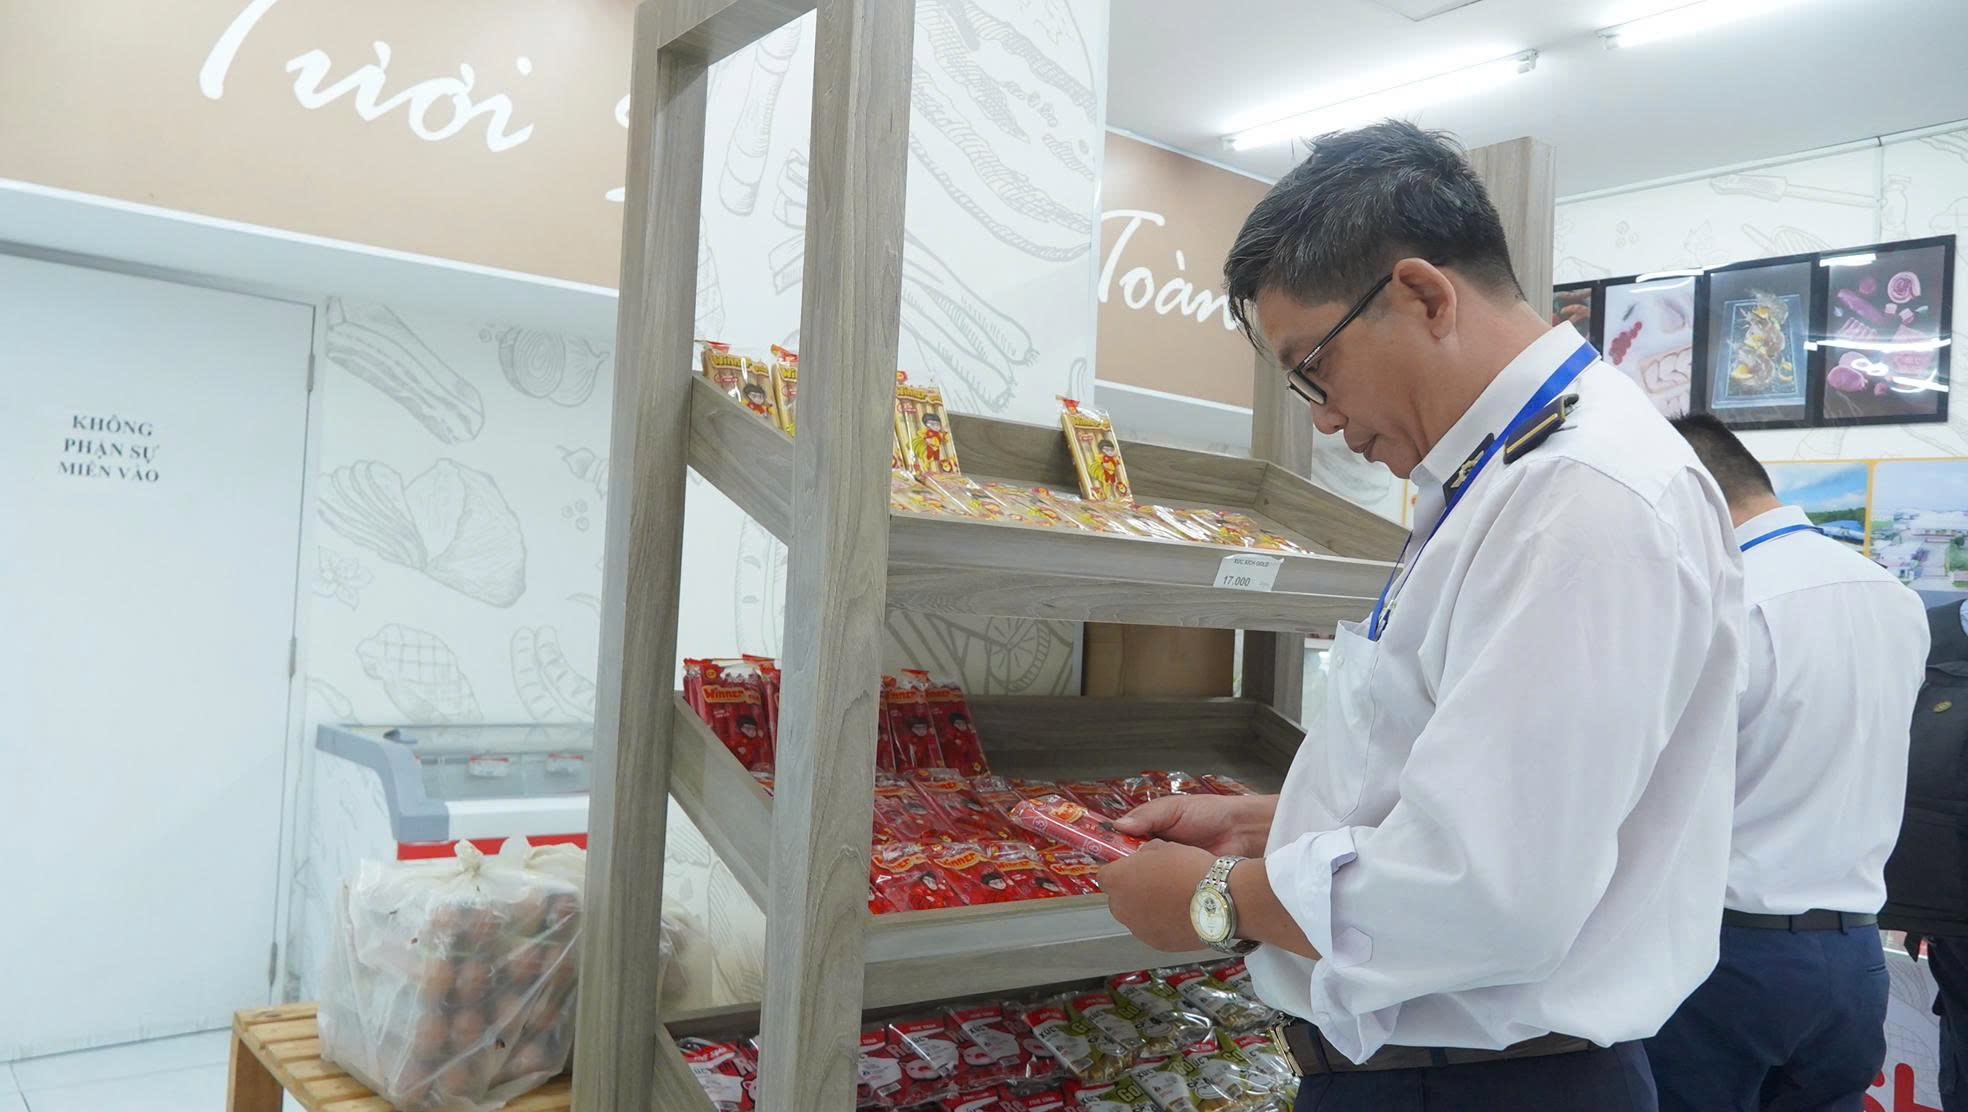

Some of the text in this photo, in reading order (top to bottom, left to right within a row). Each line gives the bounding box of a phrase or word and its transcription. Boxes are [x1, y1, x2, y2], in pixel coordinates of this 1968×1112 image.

[1098, 209, 1238, 331] Toàn
[72, 414, 153, 437] KHÔNG
[129, 443, 160, 464] SỰ
[118, 464, 159, 482] VÀO
[1223, 575, 1251, 587] 17.000
[703, 686, 745, 700] Winner
